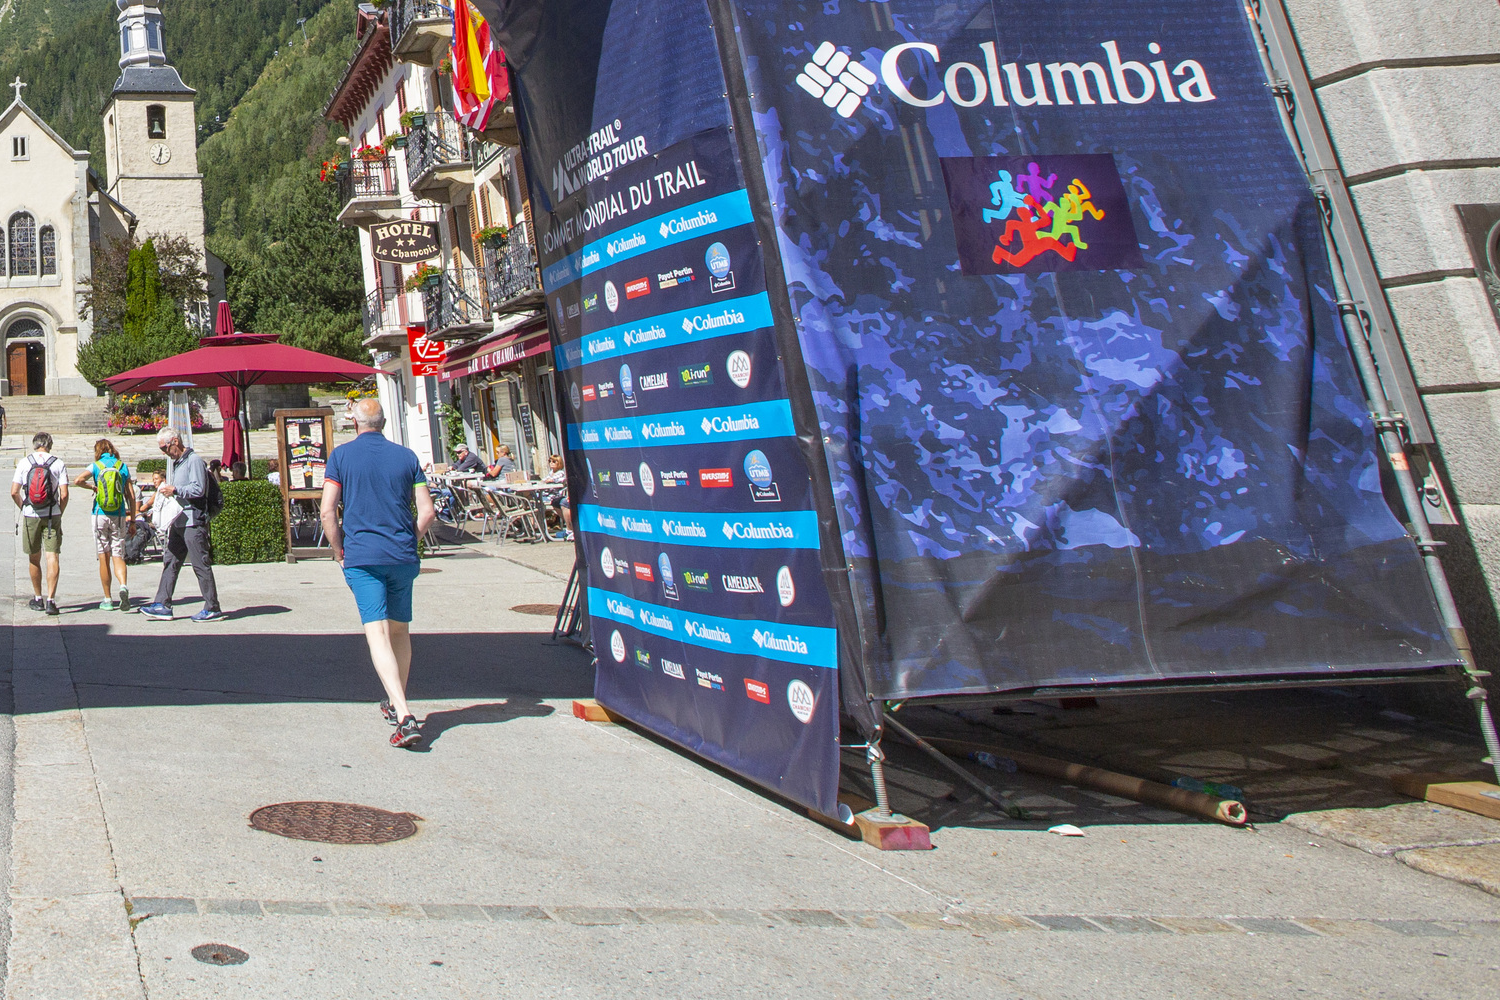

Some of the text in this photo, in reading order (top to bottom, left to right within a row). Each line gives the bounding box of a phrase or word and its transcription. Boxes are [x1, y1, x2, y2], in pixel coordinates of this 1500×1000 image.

[880, 40, 1216, 108] Columbia
[578, 135, 649, 187] WORLD TOUR
[543, 160, 706, 255] SOMMET MONDIAL DU TRAIL
[375, 223, 431, 240] HOTEL
[613, 232, 646, 254] Columbia
[668, 210, 718, 235] Columbia
[375, 244, 438, 259] Le Chamonix
[657, 267, 693, 281] Payot Pertin
[592, 309, 745, 354] Columbia Columbia Columbia
[481, 355, 490, 370] LE
[492, 342, 526, 366] CHAMONIX
[639, 372, 669, 391] CAMELBAK
[609, 427, 633, 440] Columbia
[649, 421, 685, 438] Columbia
[711, 414, 759, 432] Columbia
[660, 470, 688, 479] Payot Pertin
[749, 469, 770, 478] UTMB
[626, 517, 653, 534] Columbia
[669, 520, 706, 537] Columbia
[733, 522, 794, 539] Columbia
[722, 574, 765, 593] CAMELBAK
[645, 610, 674, 631] Columbia
[692, 621, 732, 644] Columbia
[763, 630, 808, 654] Columbia
